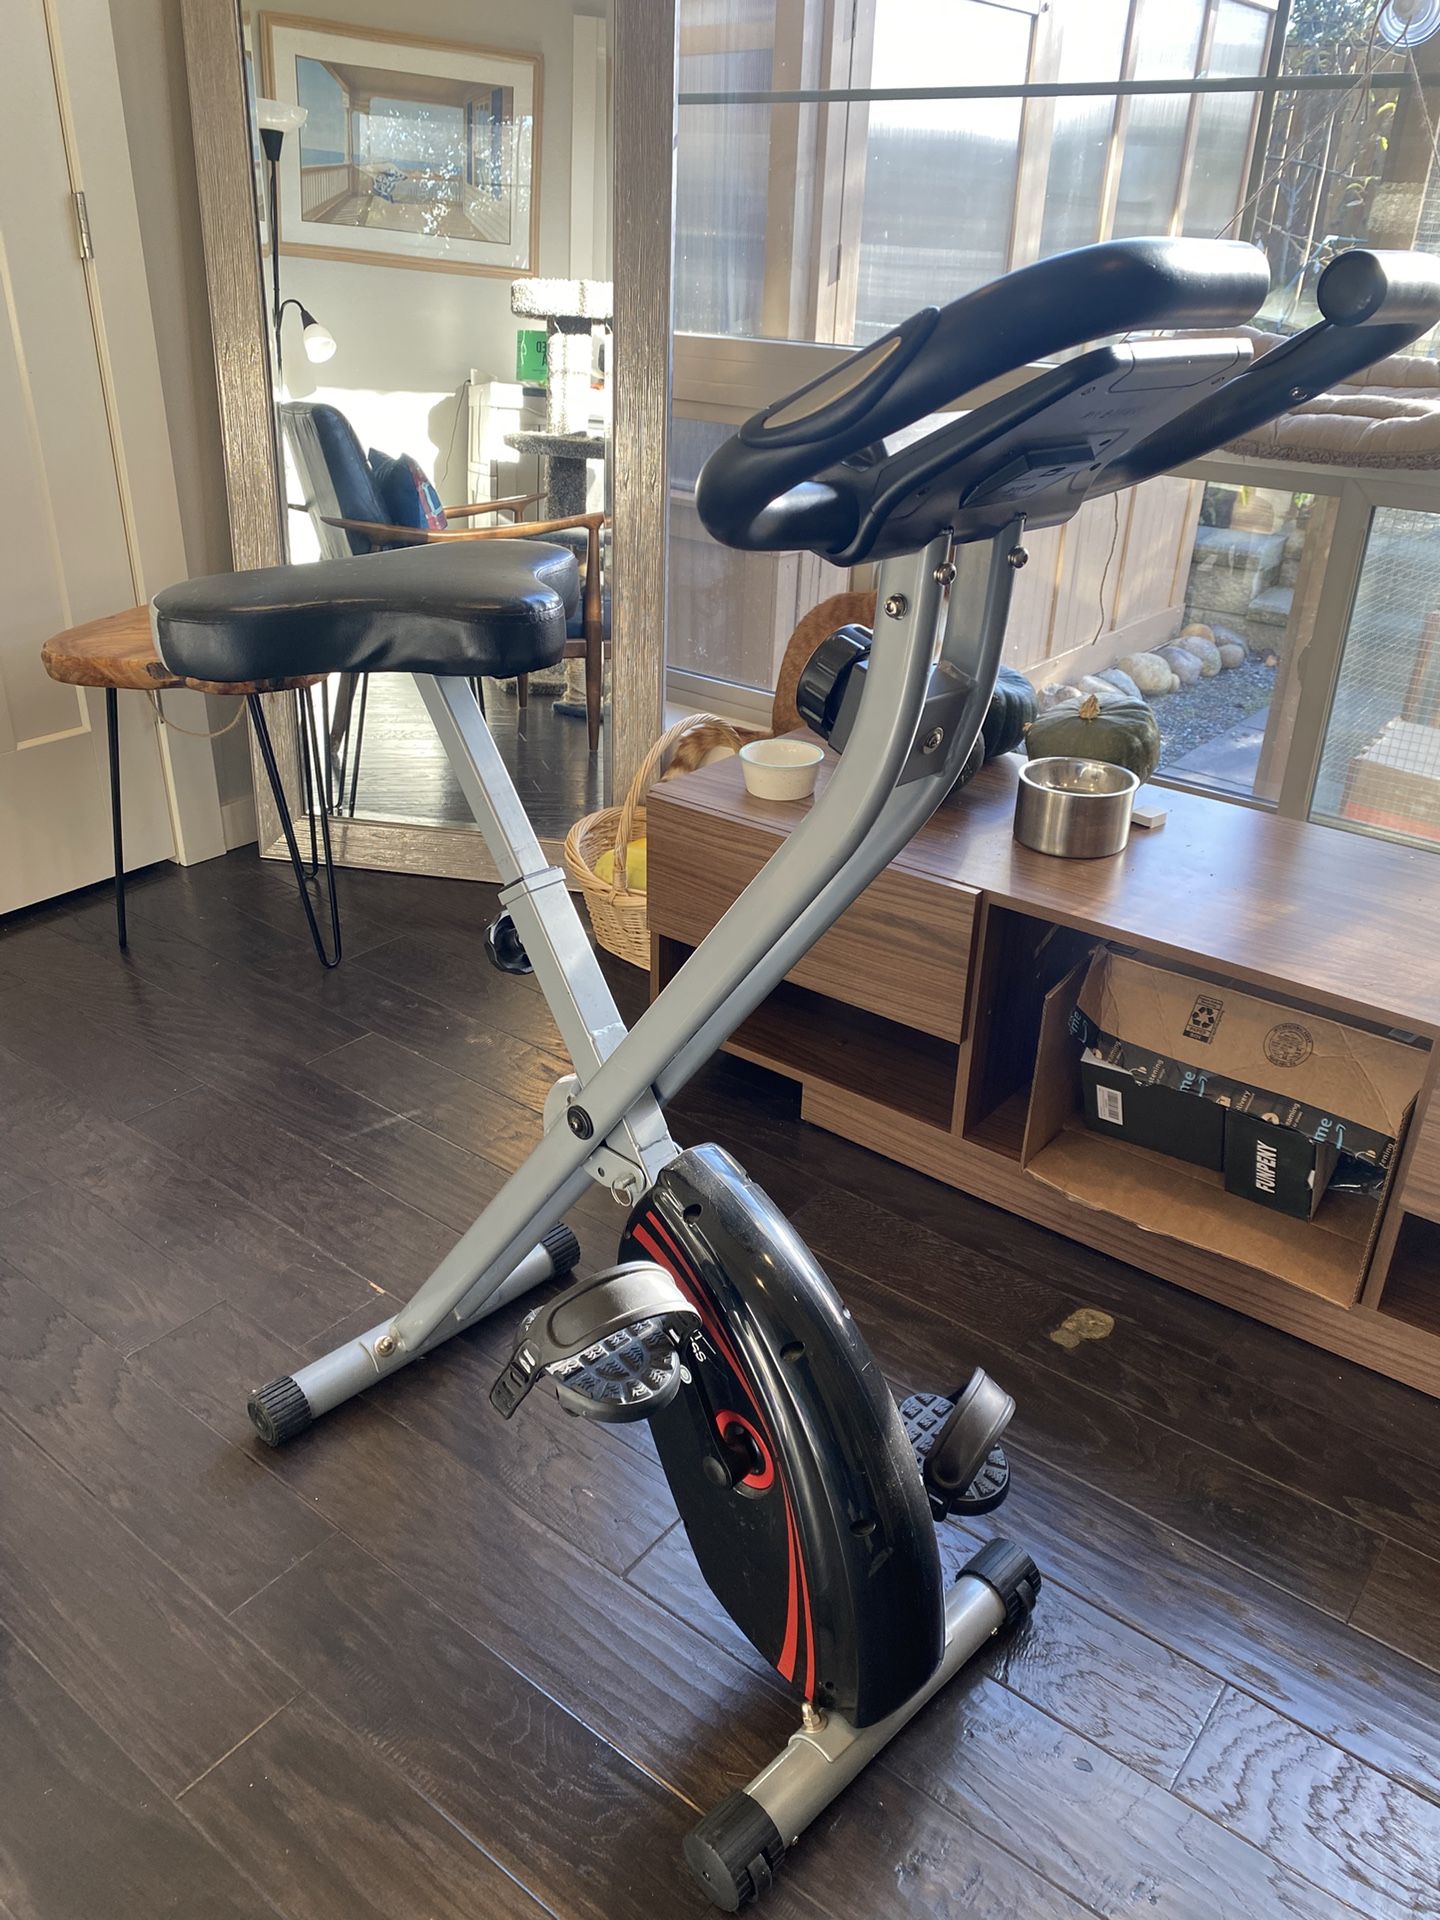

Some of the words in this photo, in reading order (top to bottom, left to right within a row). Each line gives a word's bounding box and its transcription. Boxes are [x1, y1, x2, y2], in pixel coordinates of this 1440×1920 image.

[1179, 1071, 1196, 1093] me
[1314, 1117, 1333, 1143] me
[1256, 1139, 1278, 1194] FUNPENY
